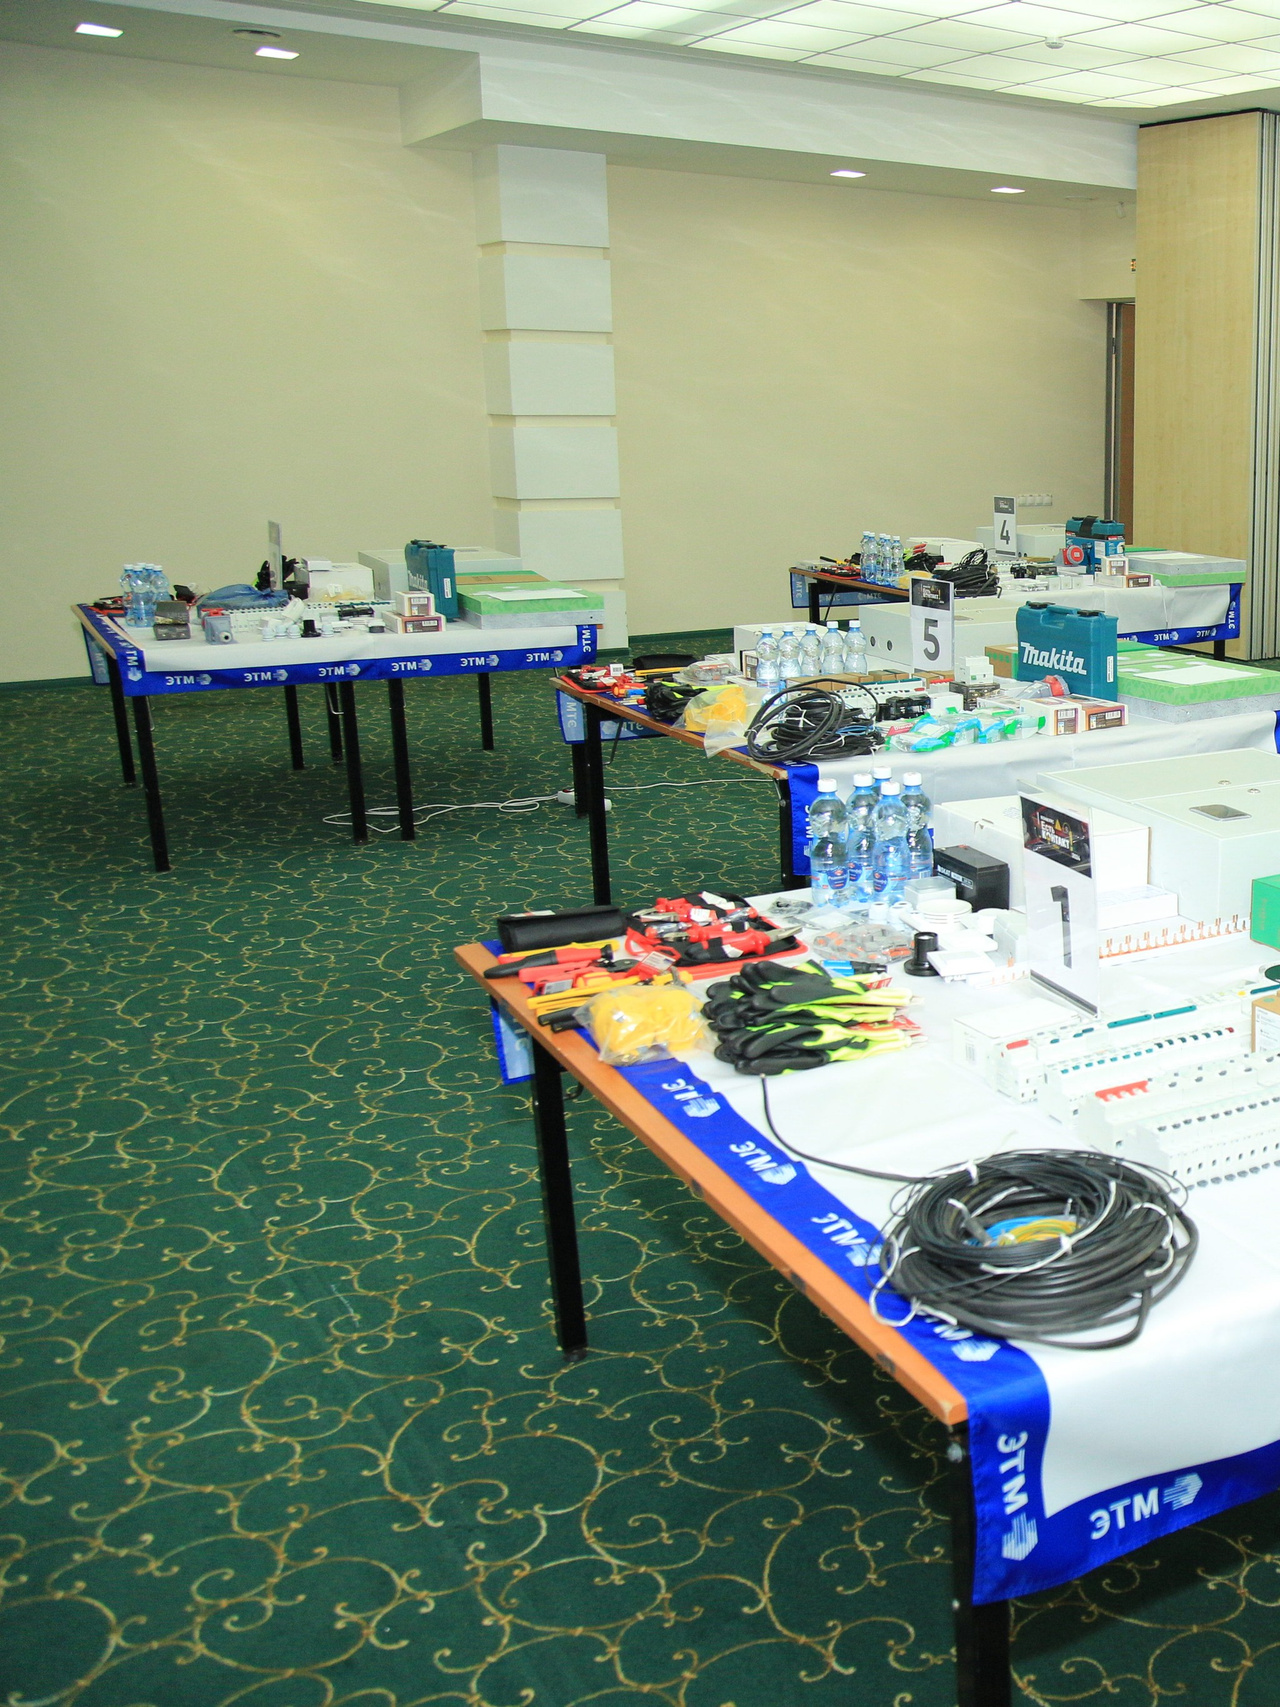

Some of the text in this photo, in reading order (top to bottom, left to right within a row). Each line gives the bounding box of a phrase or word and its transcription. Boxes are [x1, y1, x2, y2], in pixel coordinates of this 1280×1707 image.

[1000, 519, 1010, 545] 4
[582, 629, 592, 653] ЭТМ
[923, 617, 940, 661] 5
[1154, 633, 1170, 642] ЭТМ
[460, 656, 485, 667] ЭТМ
[526, 651, 550, 662] ЭТМ
[318, 666, 345, 677] ЭТМ
[391, 661, 417, 672] ЭТМ
[165, 675, 195, 686] ЭТМ
[244, 671, 272, 682] ЭТМ
[729, 1140, 778, 1171] ЭТМ
[811, 1212, 867, 1247] ЭТМ
[997, 1431, 1029, 1514] ЭТМ
[1089, 1487, 1160, 1540] ЭТМ
